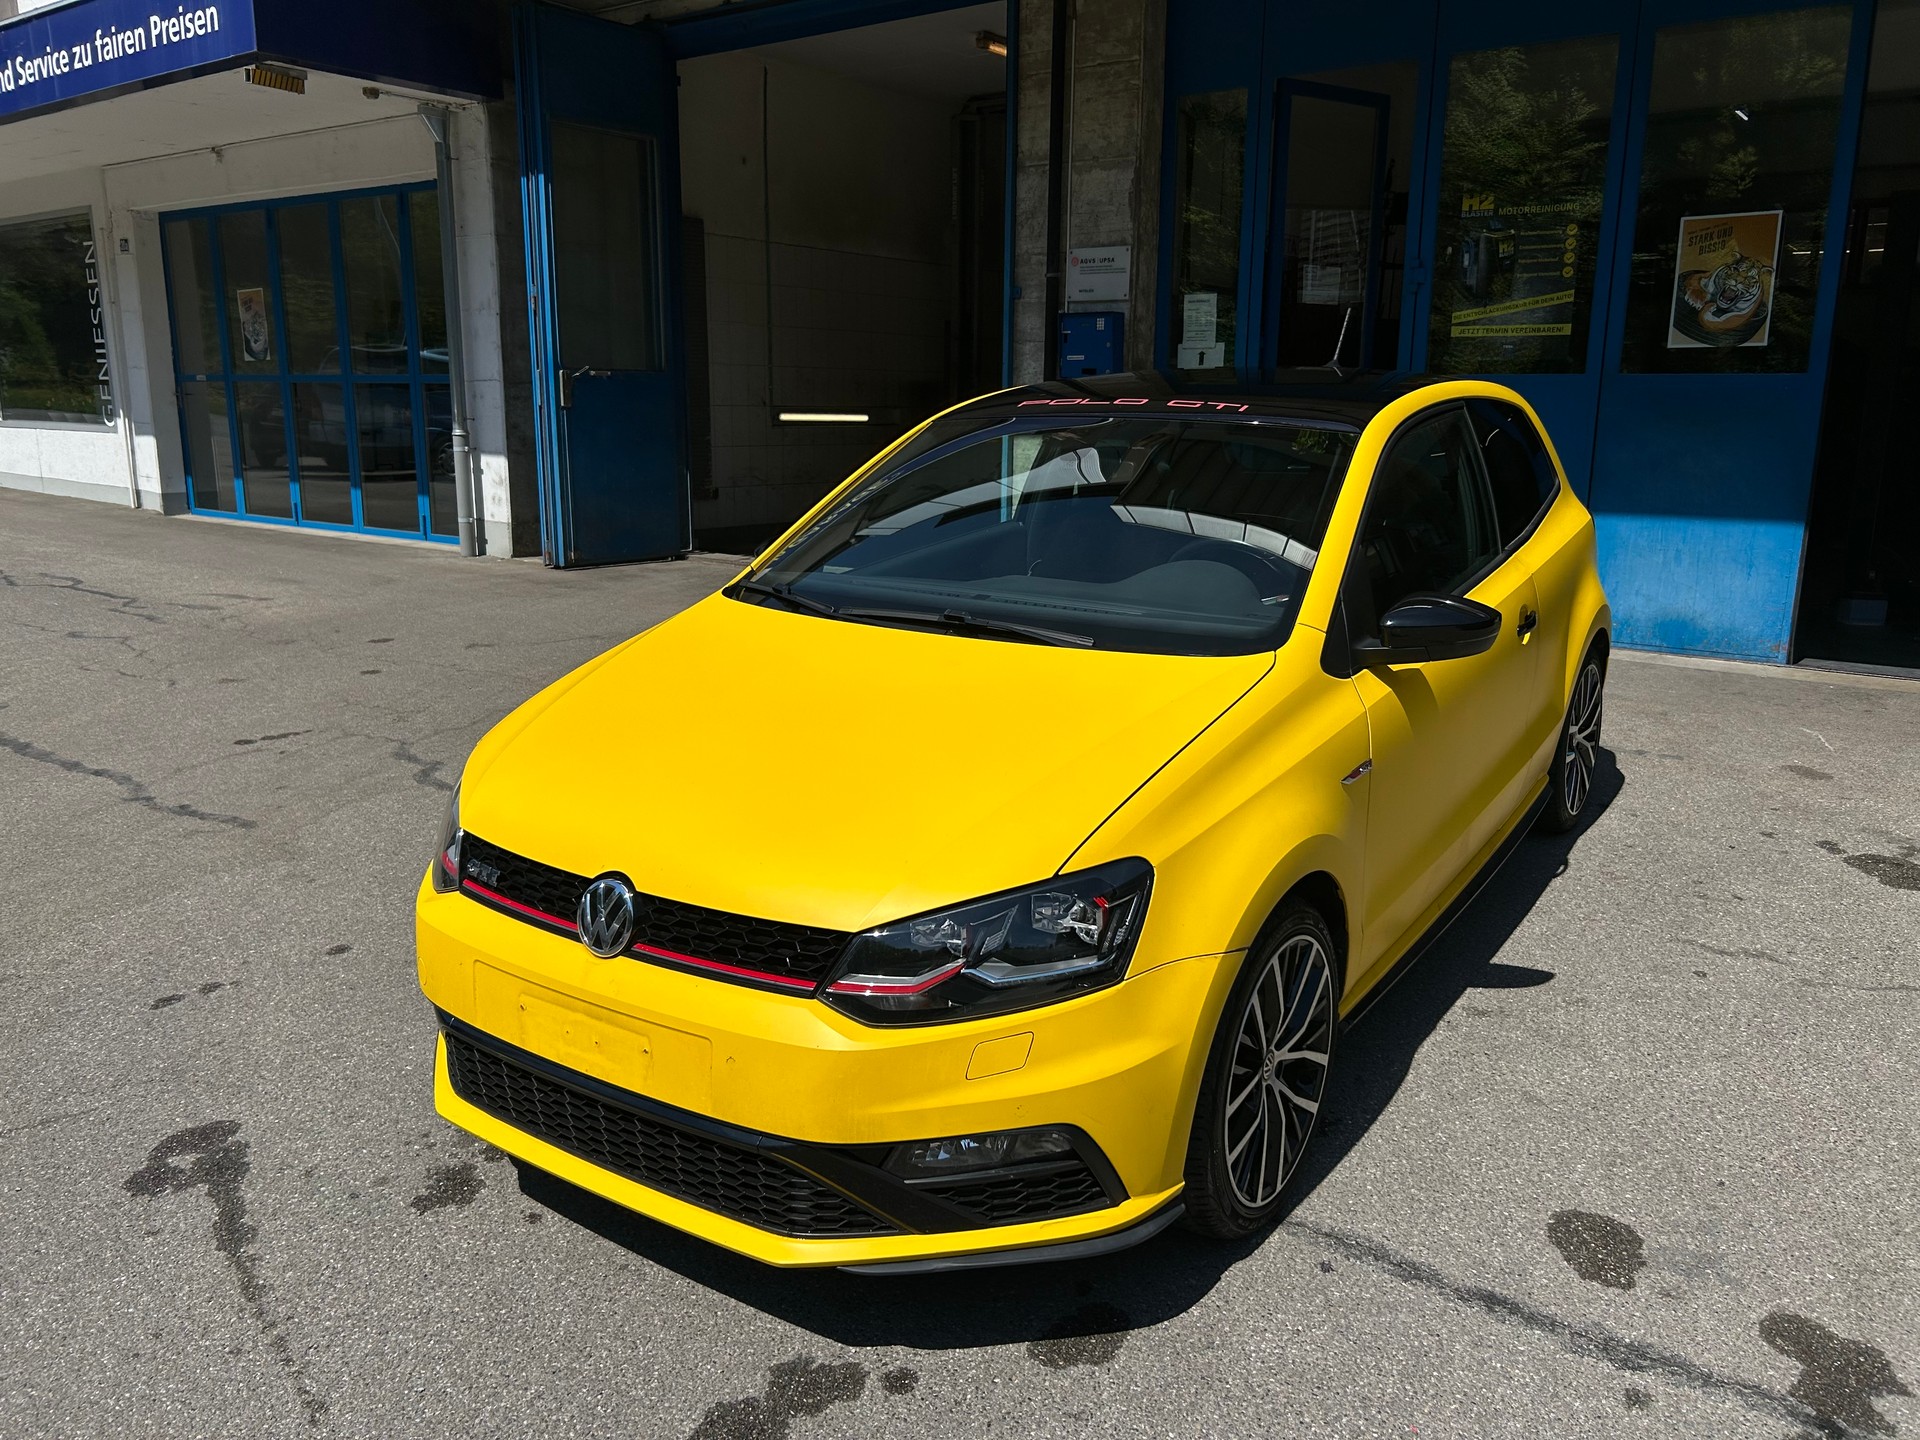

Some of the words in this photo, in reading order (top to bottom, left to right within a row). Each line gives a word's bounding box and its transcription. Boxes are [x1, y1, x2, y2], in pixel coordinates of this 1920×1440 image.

[16, 46, 69, 86] Service
[73, 42, 92, 70] zu
[95, 26, 146, 63] fairen
[150, 5, 219, 48] Preisen
[1462, 191, 1495, 211] H2
[1461, 210, 1495, 218] BLASTER
[1498, 202, 1580, 216] MOTORREINIGUNG
[1688, 231, 1715, 247] STARK
[1717, 226, 1734, 239] UND
[1541, 296, 1555, 304] DEIN
[82, 241, 116, 428] GENIESSEN
[1482, 327, 1508, 335] TERMIN
[1511, 326, 1564, 334] VEREINBAREN!
[1017, 398, 1149, 409] POLO
[1166, 399, 1250, 412] GTI
